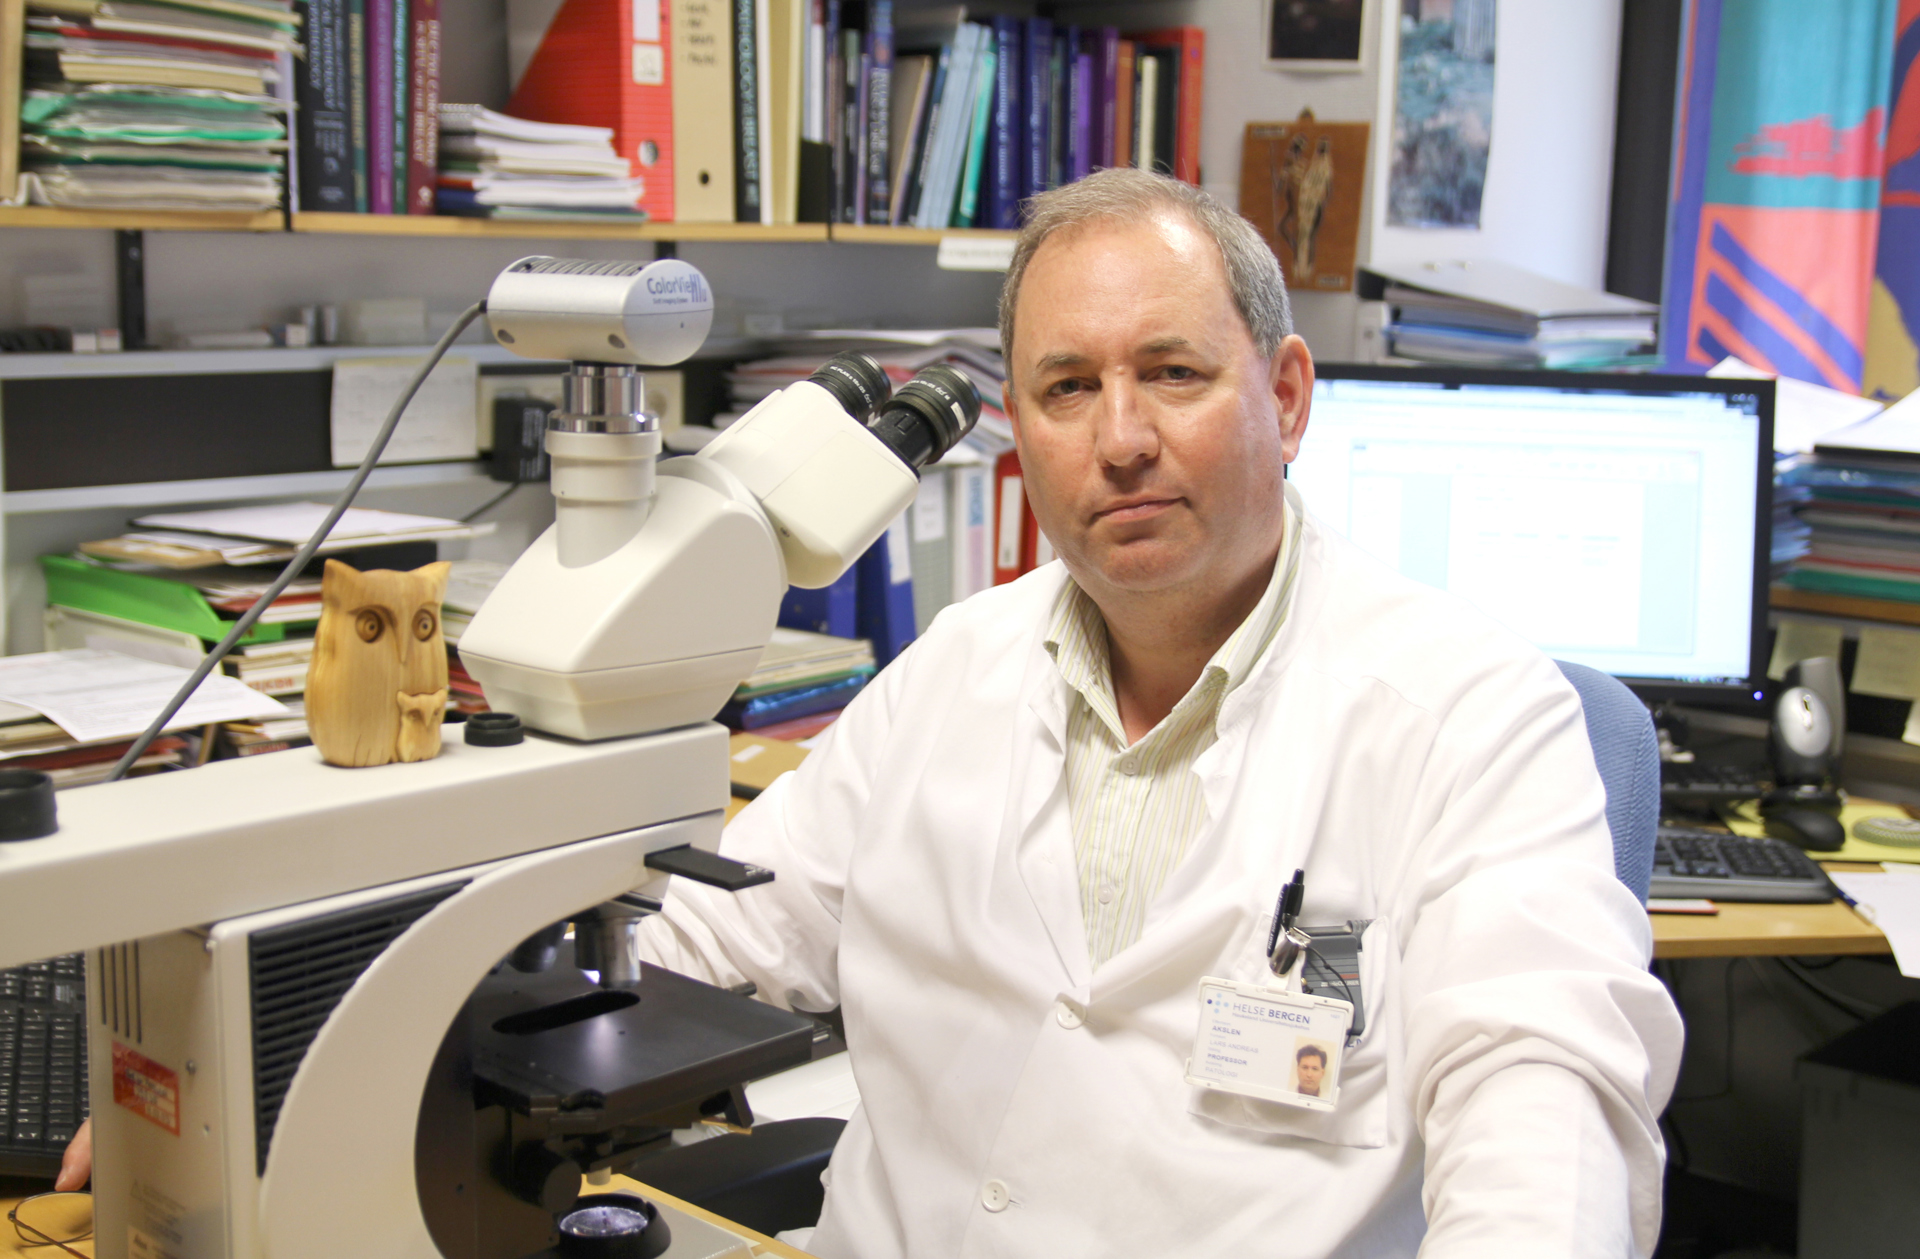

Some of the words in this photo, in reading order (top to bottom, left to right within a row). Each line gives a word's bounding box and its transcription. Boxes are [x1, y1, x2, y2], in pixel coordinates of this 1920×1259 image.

[1233, 1002, 1266, 1017] HELSE
[1267, 1008, 1311, 1025] BERGEN
[1212, 1025, 1241, 1036] AKSLEN
[1209, 1039, 1227, 1049] LARS
[1228, 1042, 1259, 1054] ANDREAS
[1207, 1053, 1248, 1066] PROFESSOR
[1204, 1066, 1239, 1079] PATOLOGI
